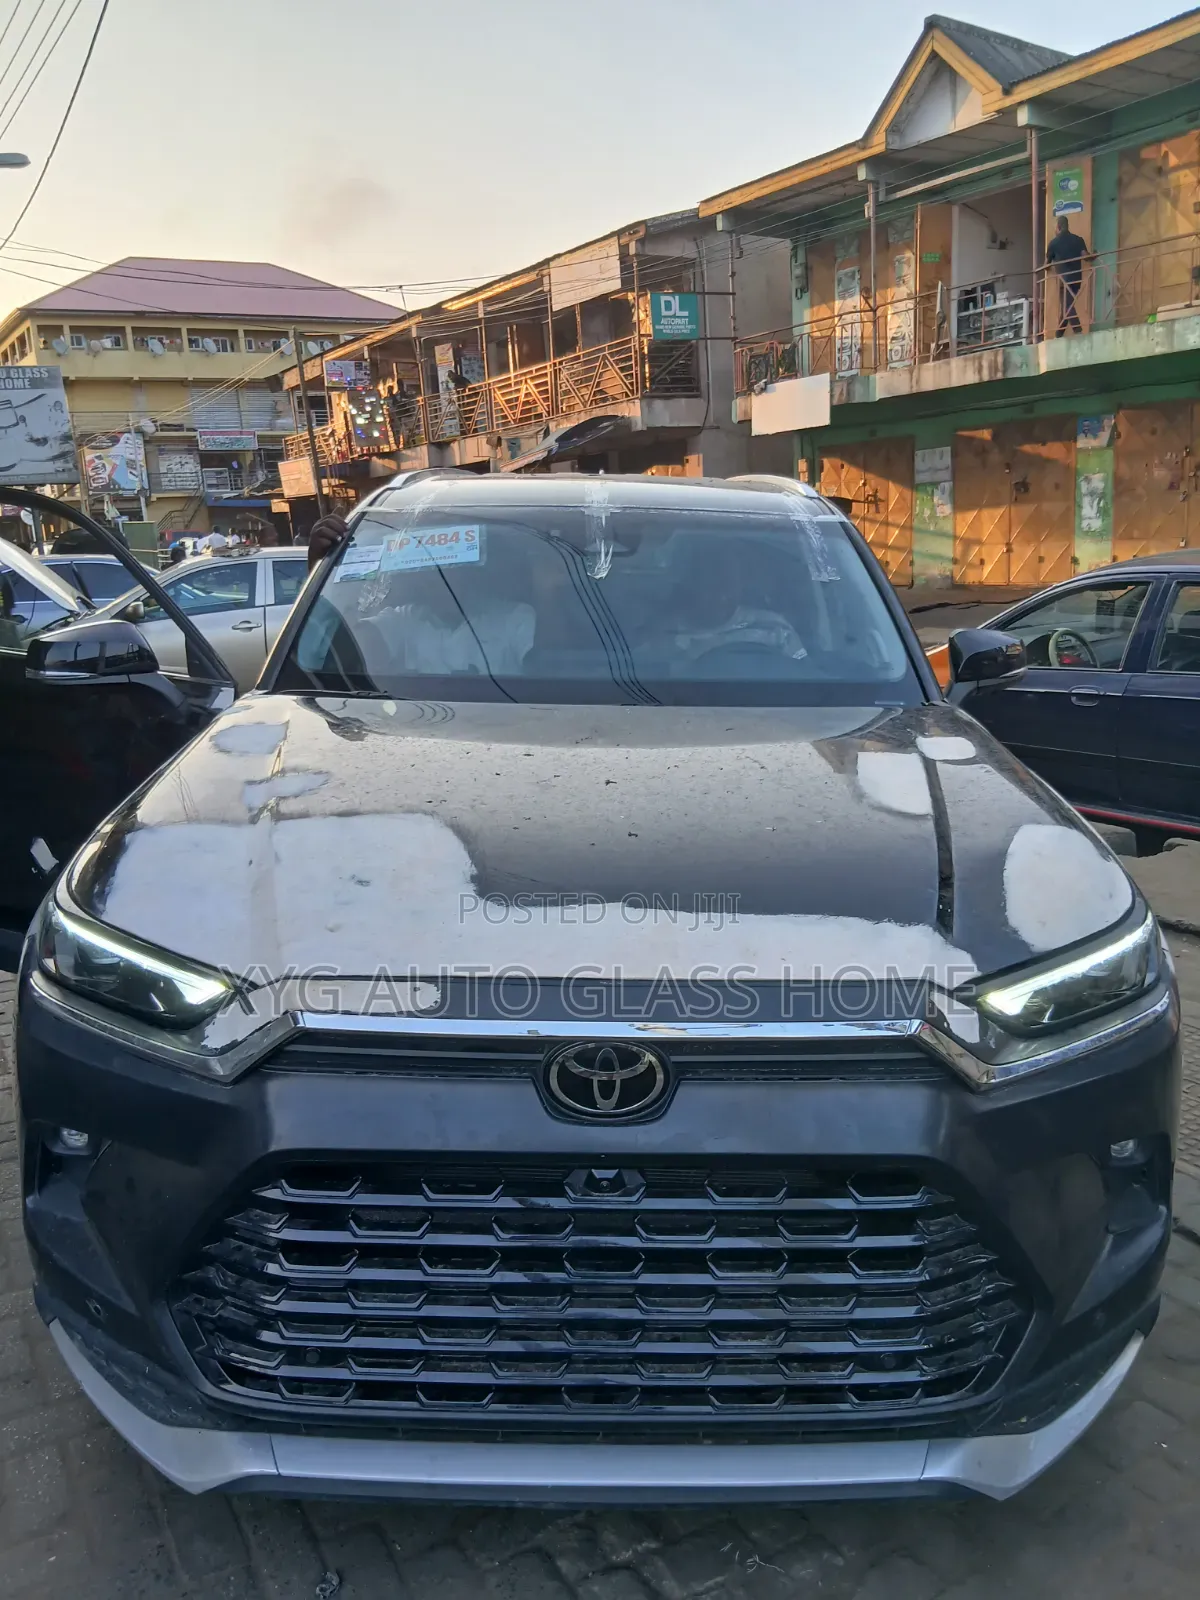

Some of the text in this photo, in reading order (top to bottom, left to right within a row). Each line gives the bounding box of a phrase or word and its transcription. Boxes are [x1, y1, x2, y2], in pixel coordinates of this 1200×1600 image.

[660, 295, 689, 317] DL
[10, 367, 49, 379] GLASS
[414, 531, 461, 549] 7484
[464, 529, 476, 543] S
